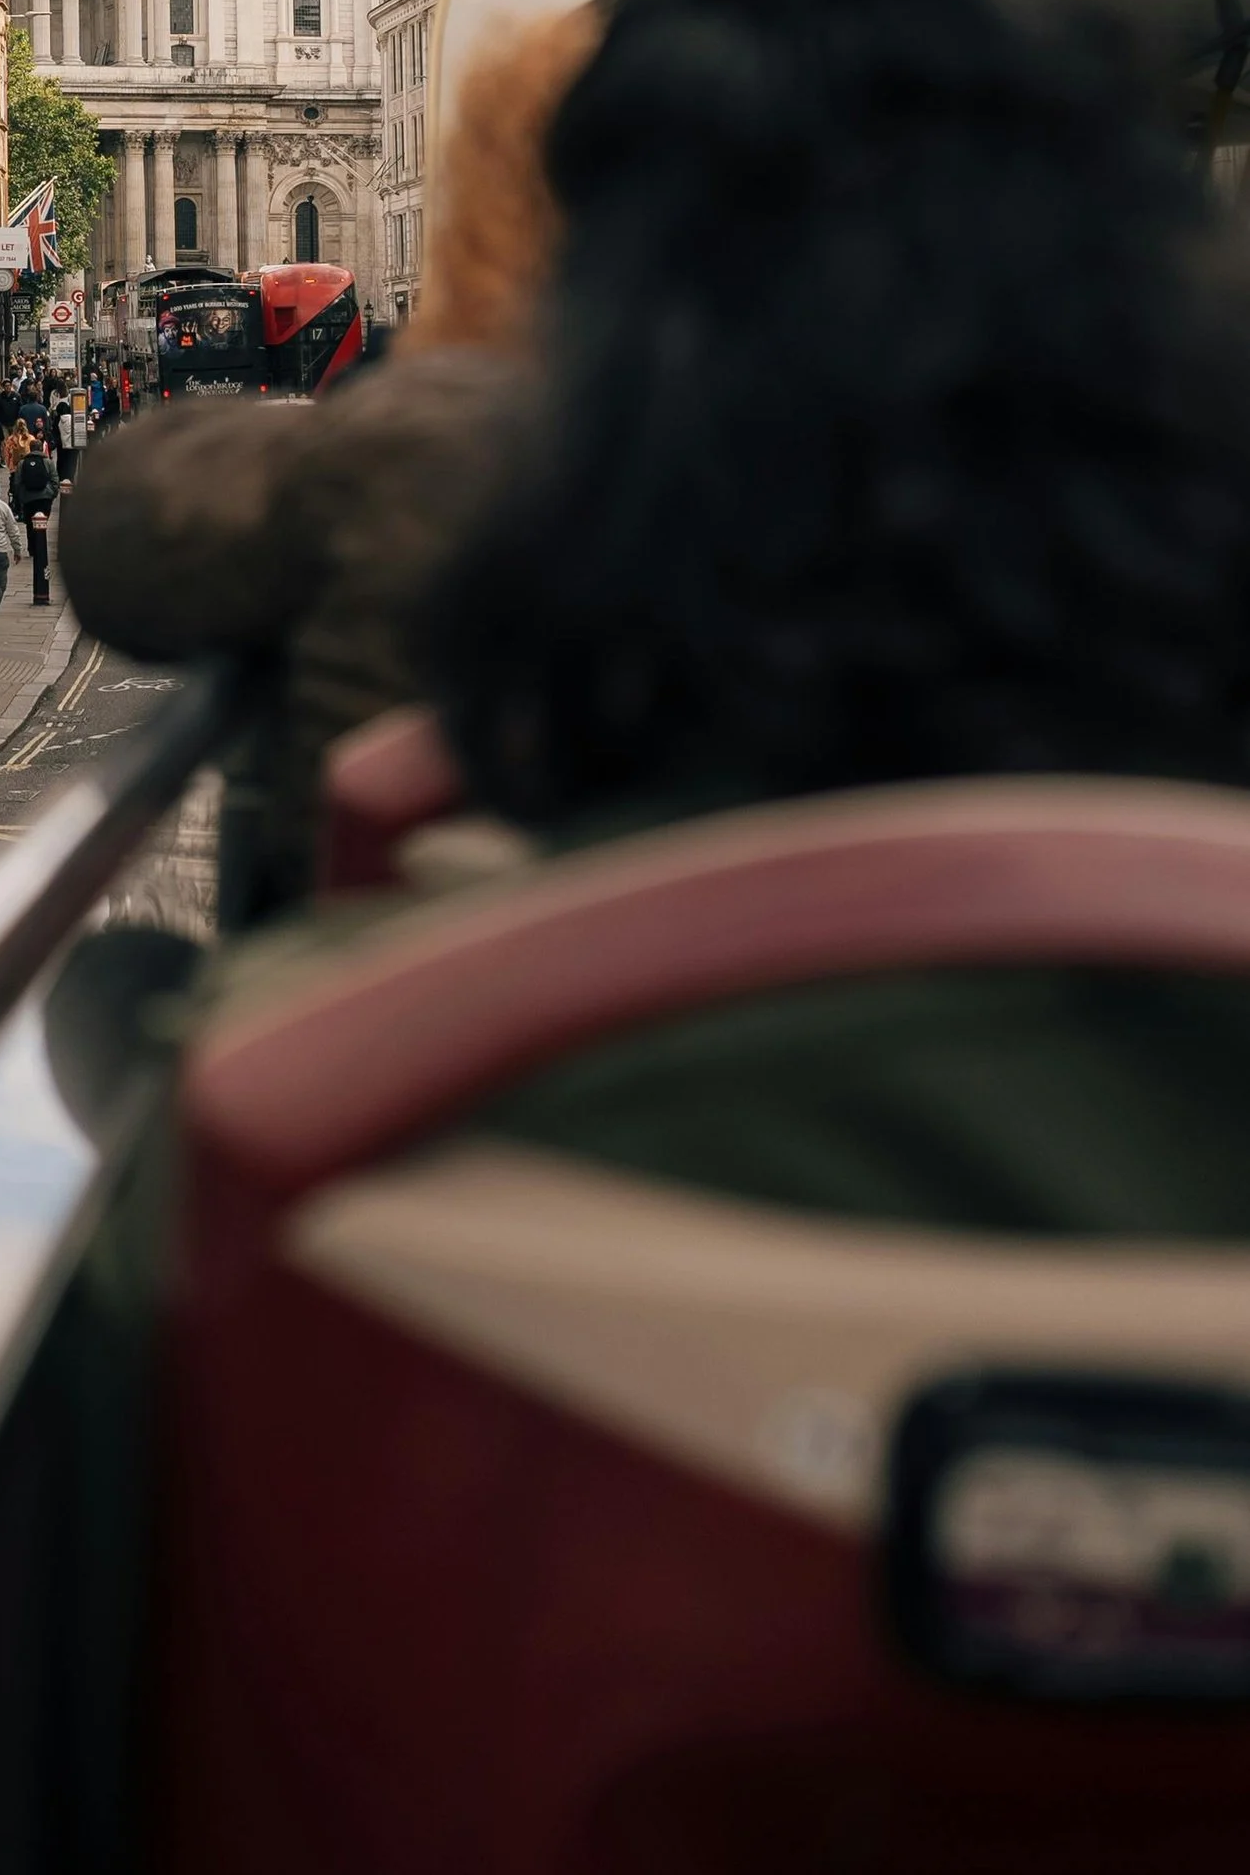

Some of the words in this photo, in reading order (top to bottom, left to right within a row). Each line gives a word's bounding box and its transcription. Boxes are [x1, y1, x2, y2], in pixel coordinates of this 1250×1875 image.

[1, 243, 15, 251] LET
[73, 291, 83, 302] G
[312, 328, 323, 340] 17
